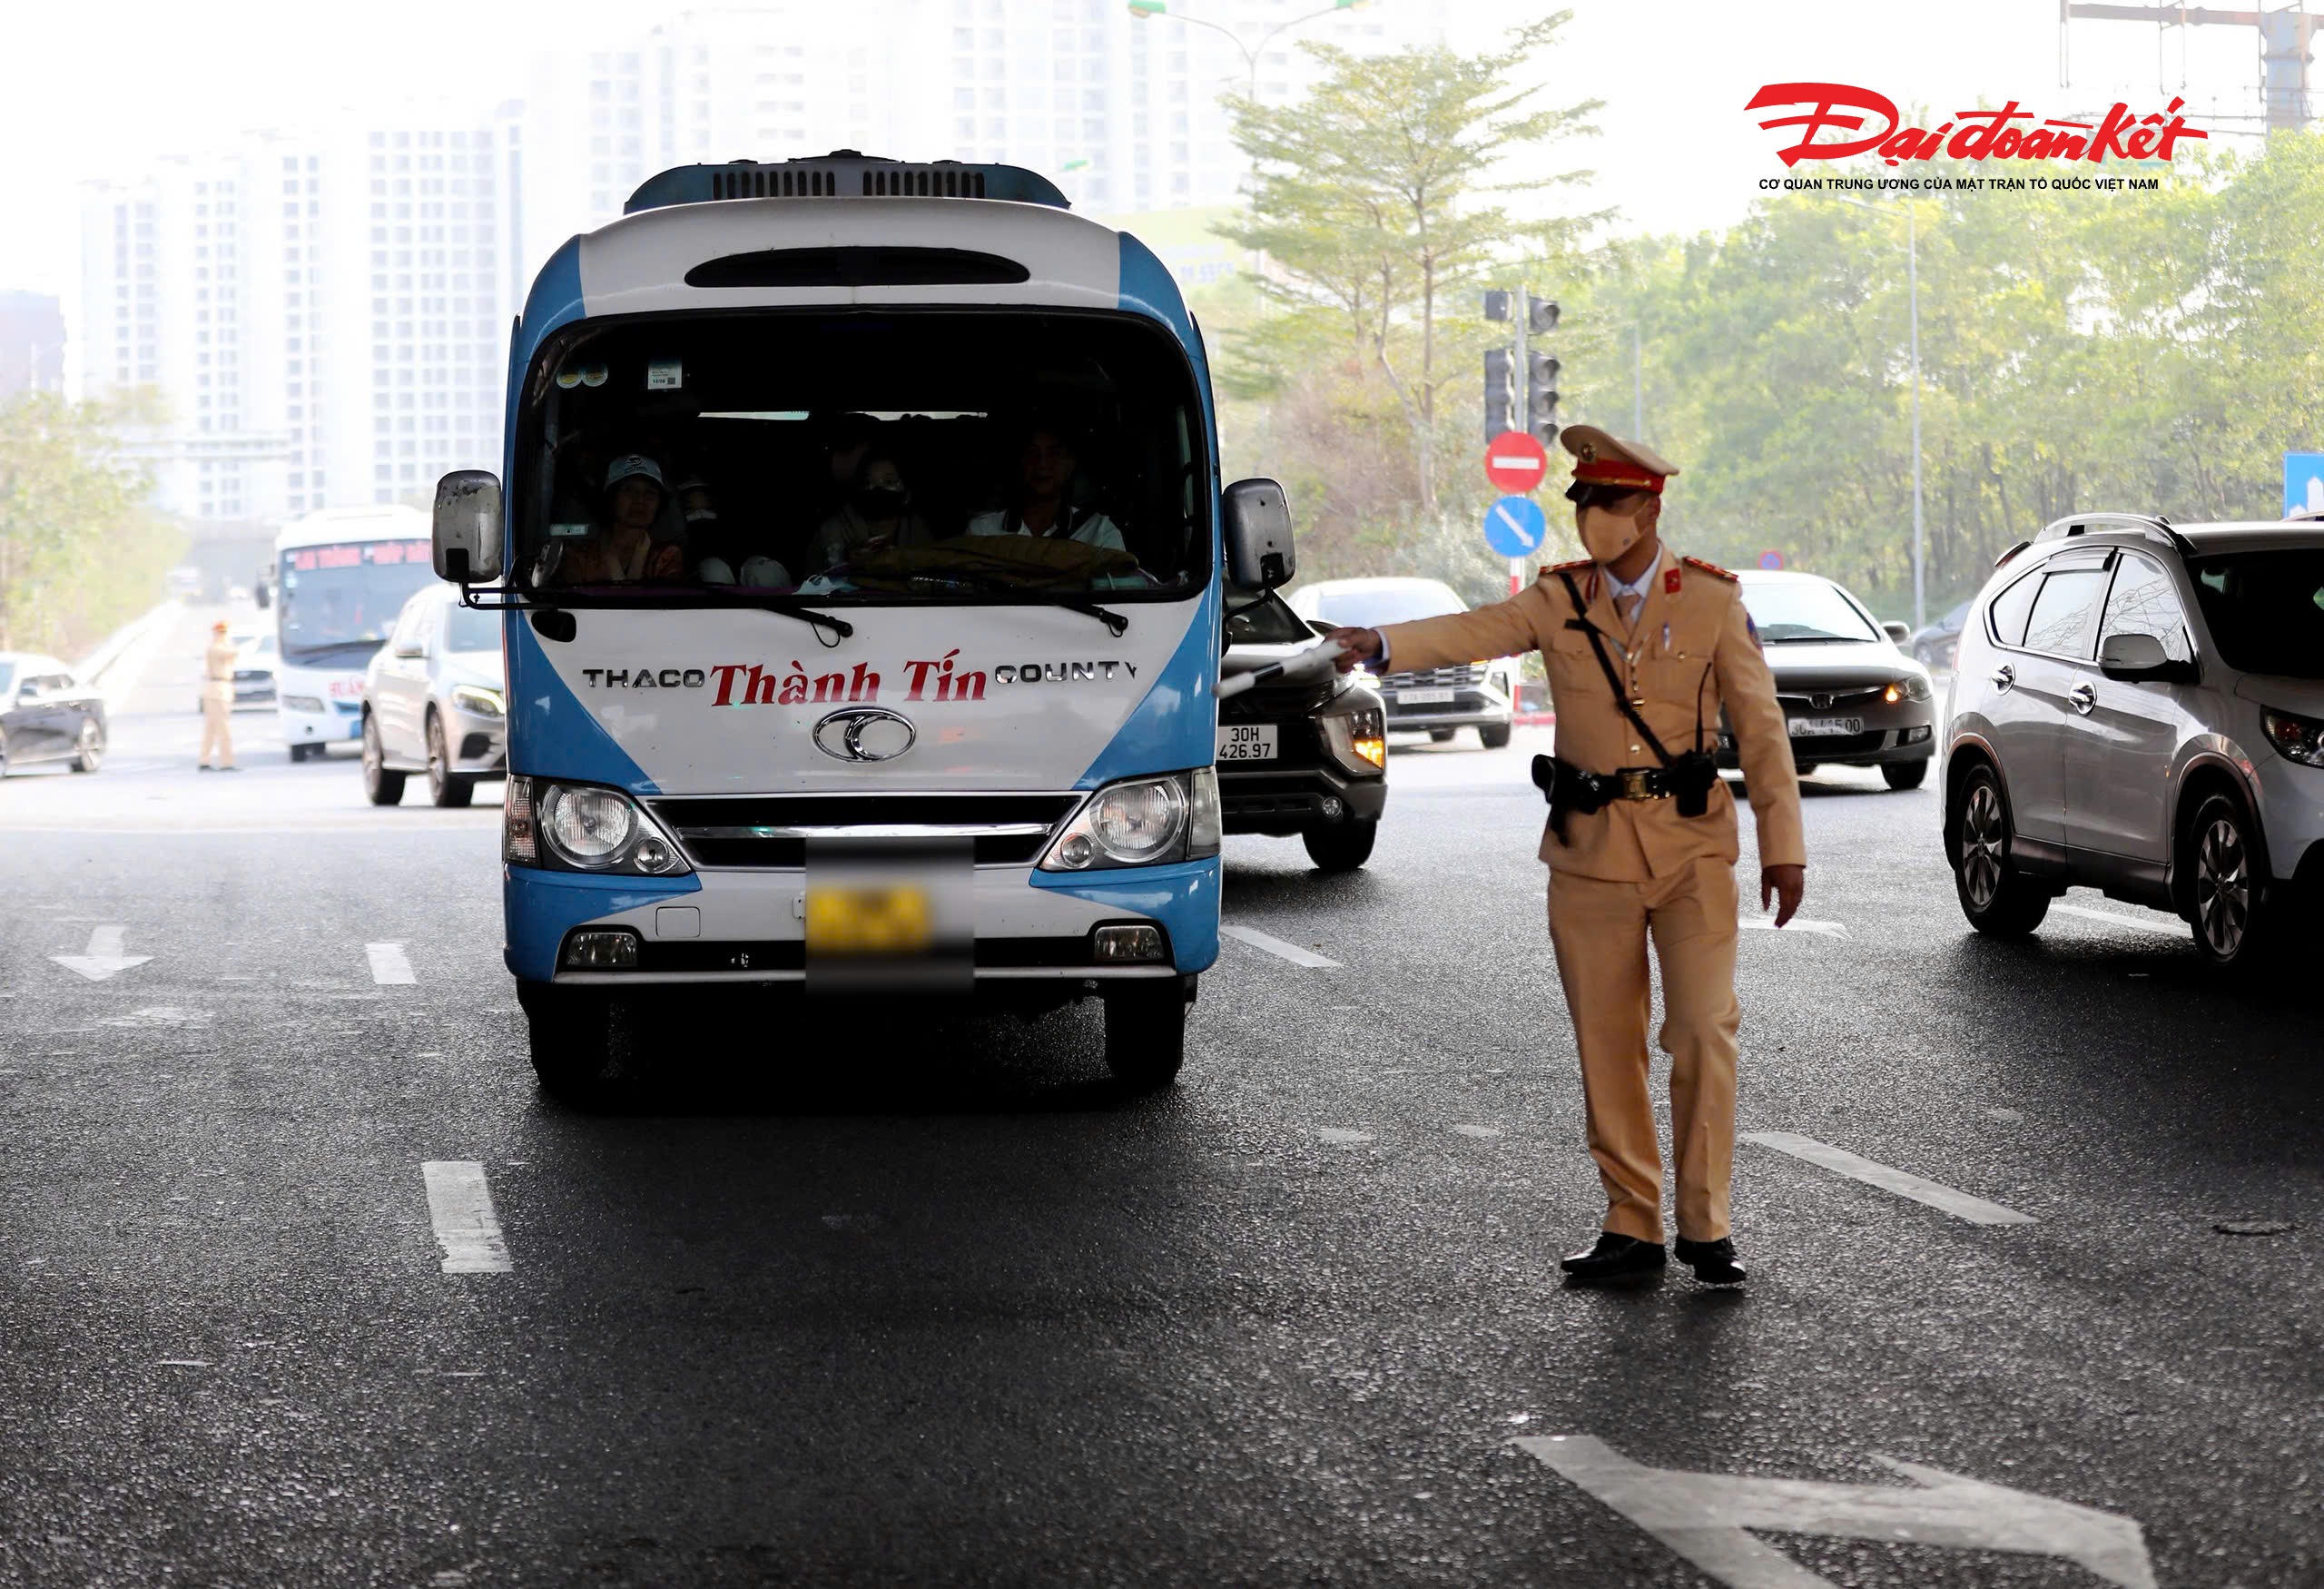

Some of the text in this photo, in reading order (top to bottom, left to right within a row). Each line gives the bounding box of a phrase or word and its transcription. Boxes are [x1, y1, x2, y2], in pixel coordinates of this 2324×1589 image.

[582, 668, 705, 688] THACO
[709, 647, 988, 706] Thành Tín
[1230, 726, 1259, 742] 30H
[1219, 743, 1271, 759] 426.97
